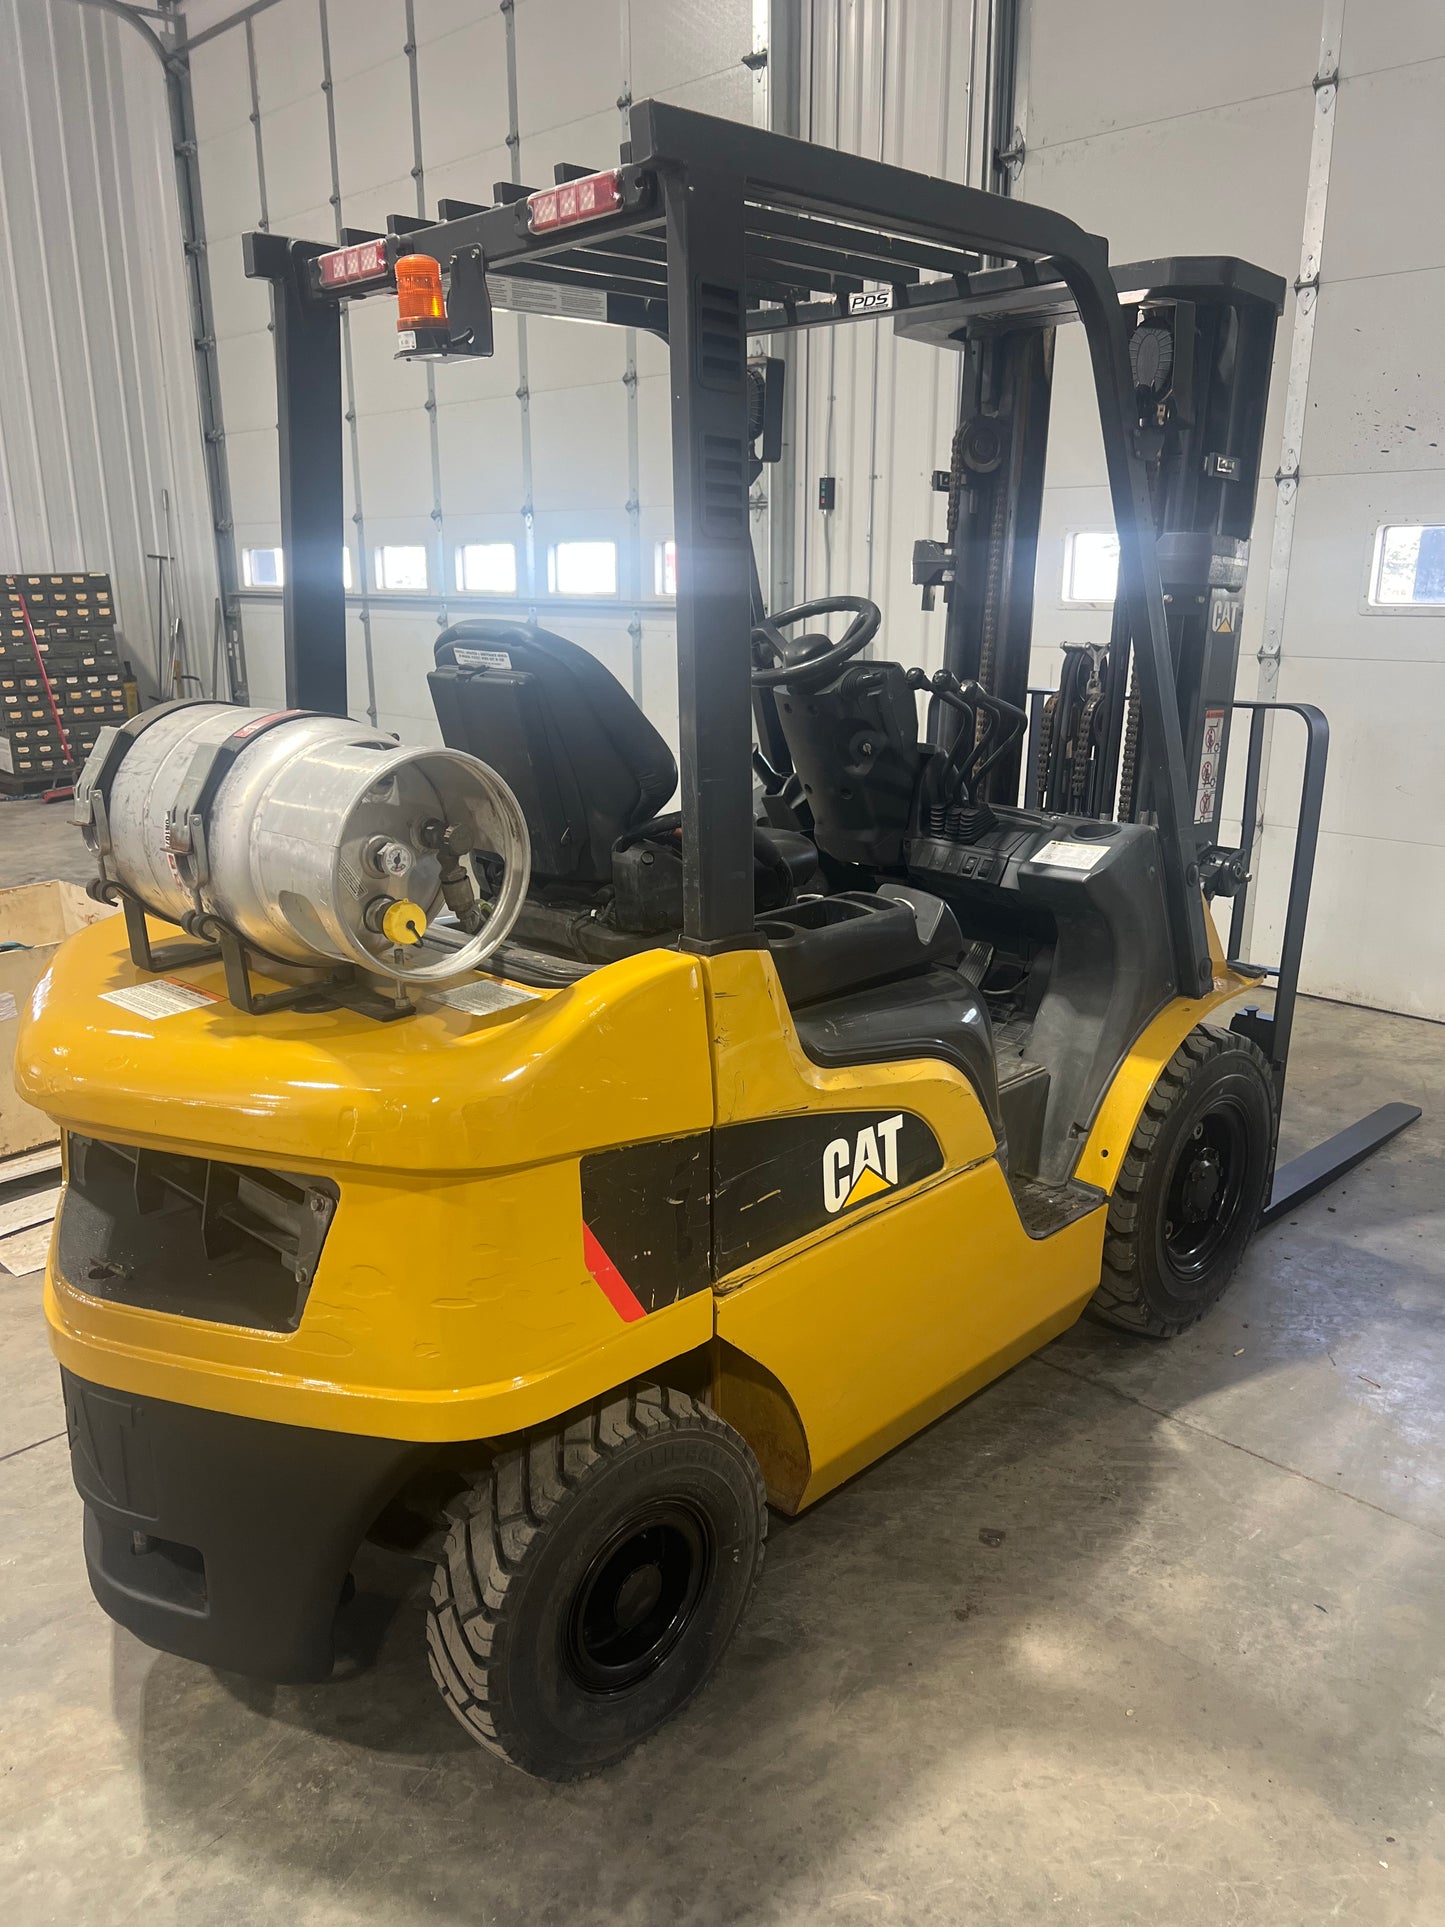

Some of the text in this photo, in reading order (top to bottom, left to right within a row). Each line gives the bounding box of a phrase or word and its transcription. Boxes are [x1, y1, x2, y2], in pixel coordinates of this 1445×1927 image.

[852, 293, 889, 308] PDS
[1212, 600, 1240, 632] CAT
[823, 1114, 903, 1213] CAT
